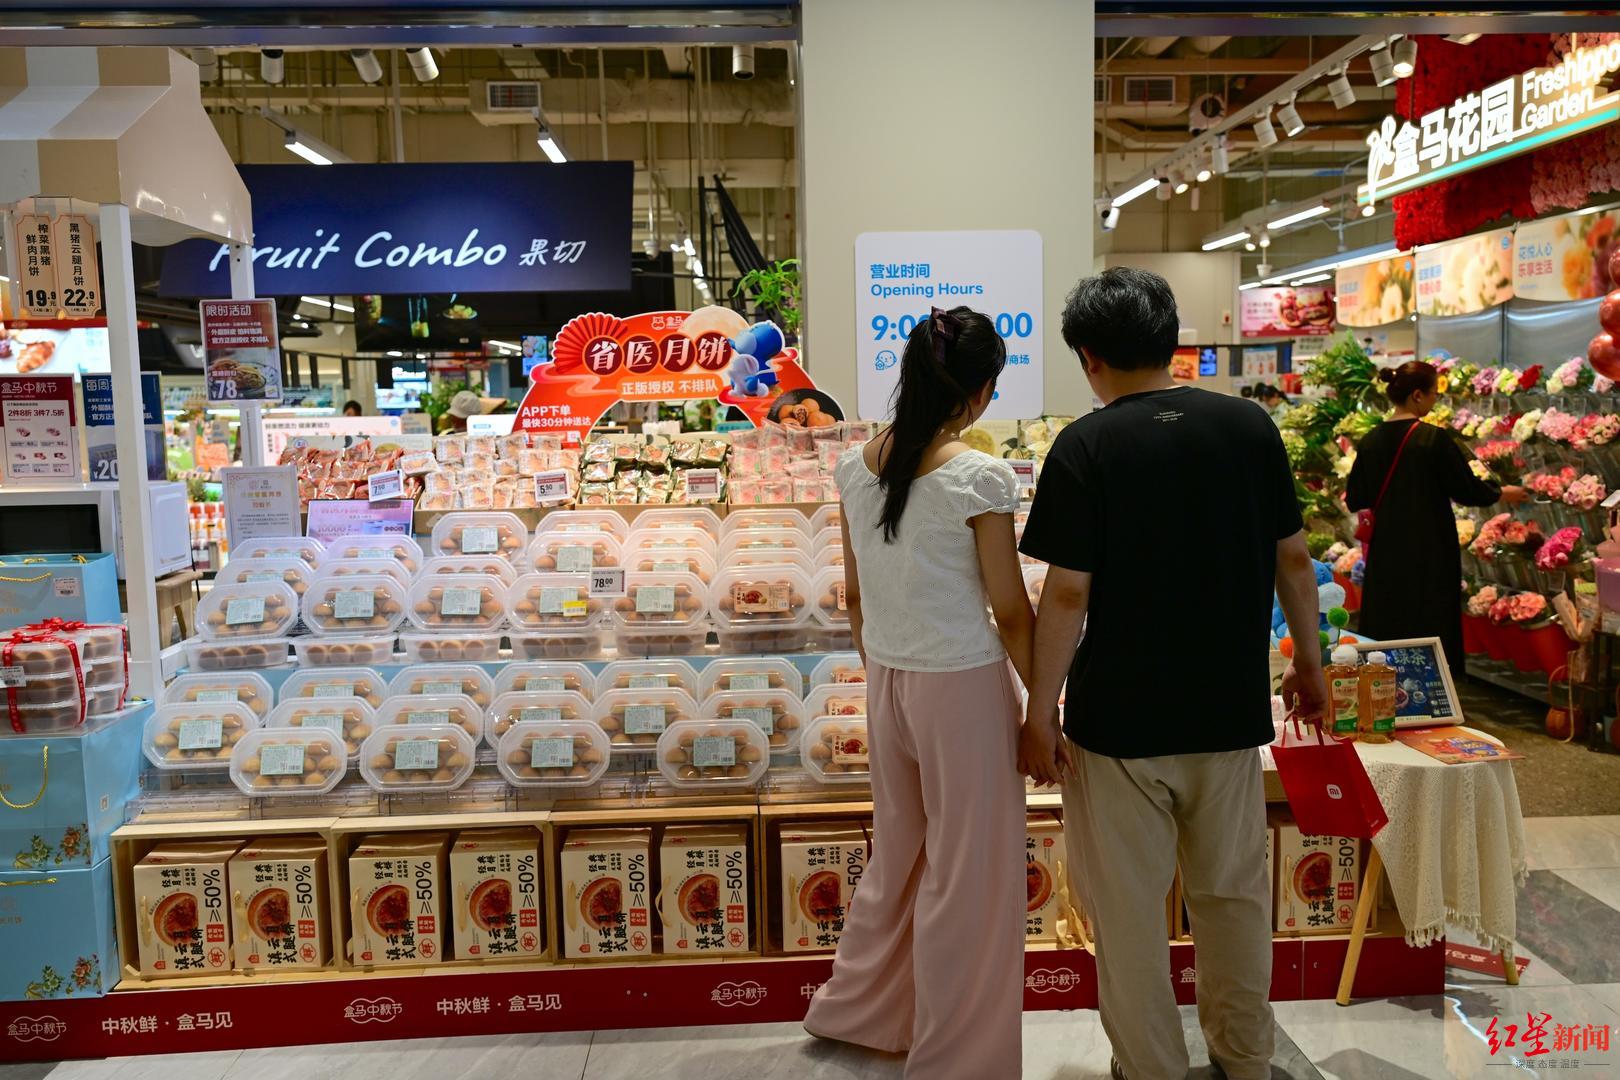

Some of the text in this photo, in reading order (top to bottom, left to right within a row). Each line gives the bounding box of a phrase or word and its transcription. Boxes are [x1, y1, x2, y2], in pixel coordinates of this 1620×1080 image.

[1522, 43, 1620, 103] Freshippo
[1521, 87, 1594, 132] Garden
[1392, 77, 1515, 178] 盒马花园
[38, 223, 51, 266] 榨菜黑猪
[354, 228, 508, 269] Combo
[518, 237, 587, 266] 果切
[26, 234, 39, 277] 鲜肉月饼
[69, 223, 84, 286] 黑猪云腿月饼
[870, 263, 931, 279] 营业时间
[870, 282, 983, 298] Opening Hours
[205, 304, 251, 317] 限时活动
[589, 338, 729, 371] 省医月饼
[1, 382, 57, 394] 盒马中秋节
[86, 378, 112, 392] 每周
[621, 377, 719, 395] 正版授权 不排队
[8, 409, 65, 417] 2件8折 3件7.5折
[521, 405, 571, 418] APP下单
[521, 417, 592, 429] 最快30分钟送达
[1025, 972, 1081, 988] 盒马中秋节
[710, 986, 768, 1001] 盒马中秋节
[344, 1003, 403, 1019] 盒马中秋节
[7, 1021, 67, 1036] 盒马中秋节
